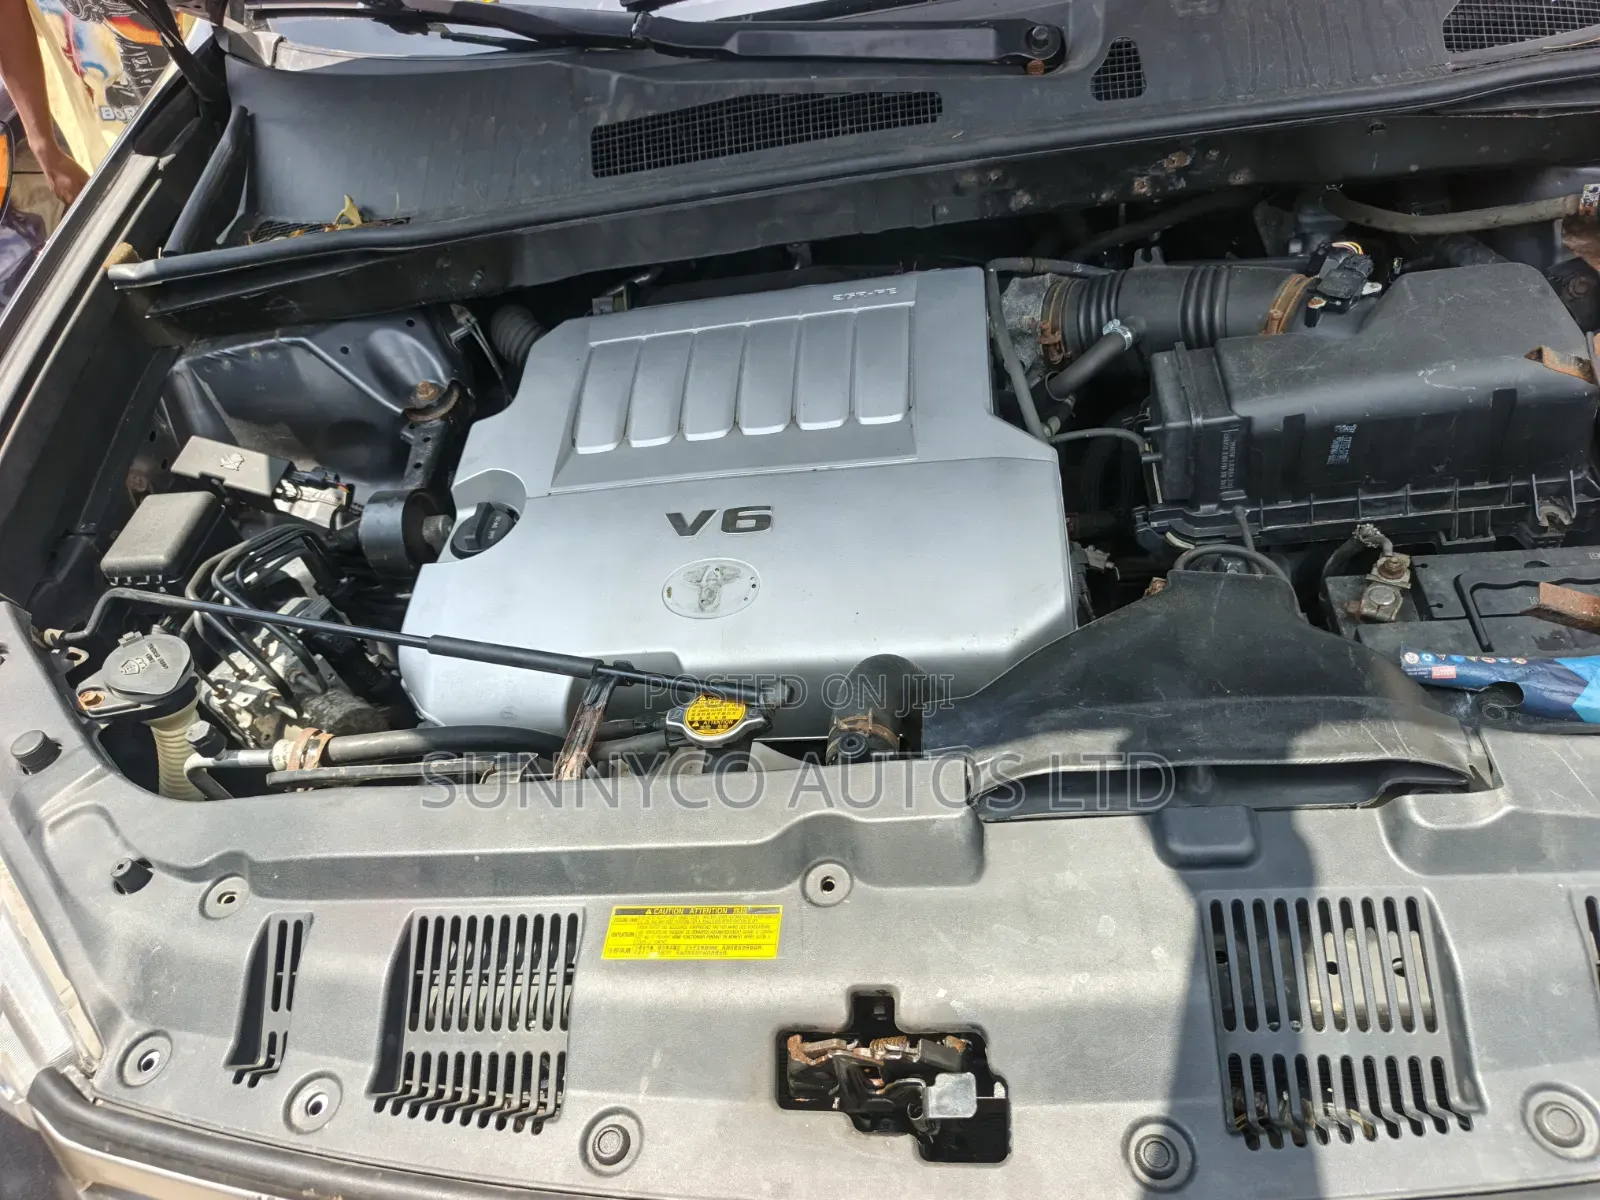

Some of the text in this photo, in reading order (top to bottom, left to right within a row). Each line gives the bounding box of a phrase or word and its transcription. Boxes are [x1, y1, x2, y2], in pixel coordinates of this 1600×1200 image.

[665, 505, 773, 537] V6
[653, 907, 684, 915] CAUTION
[688, 907, 728, 915] ATTENTION
